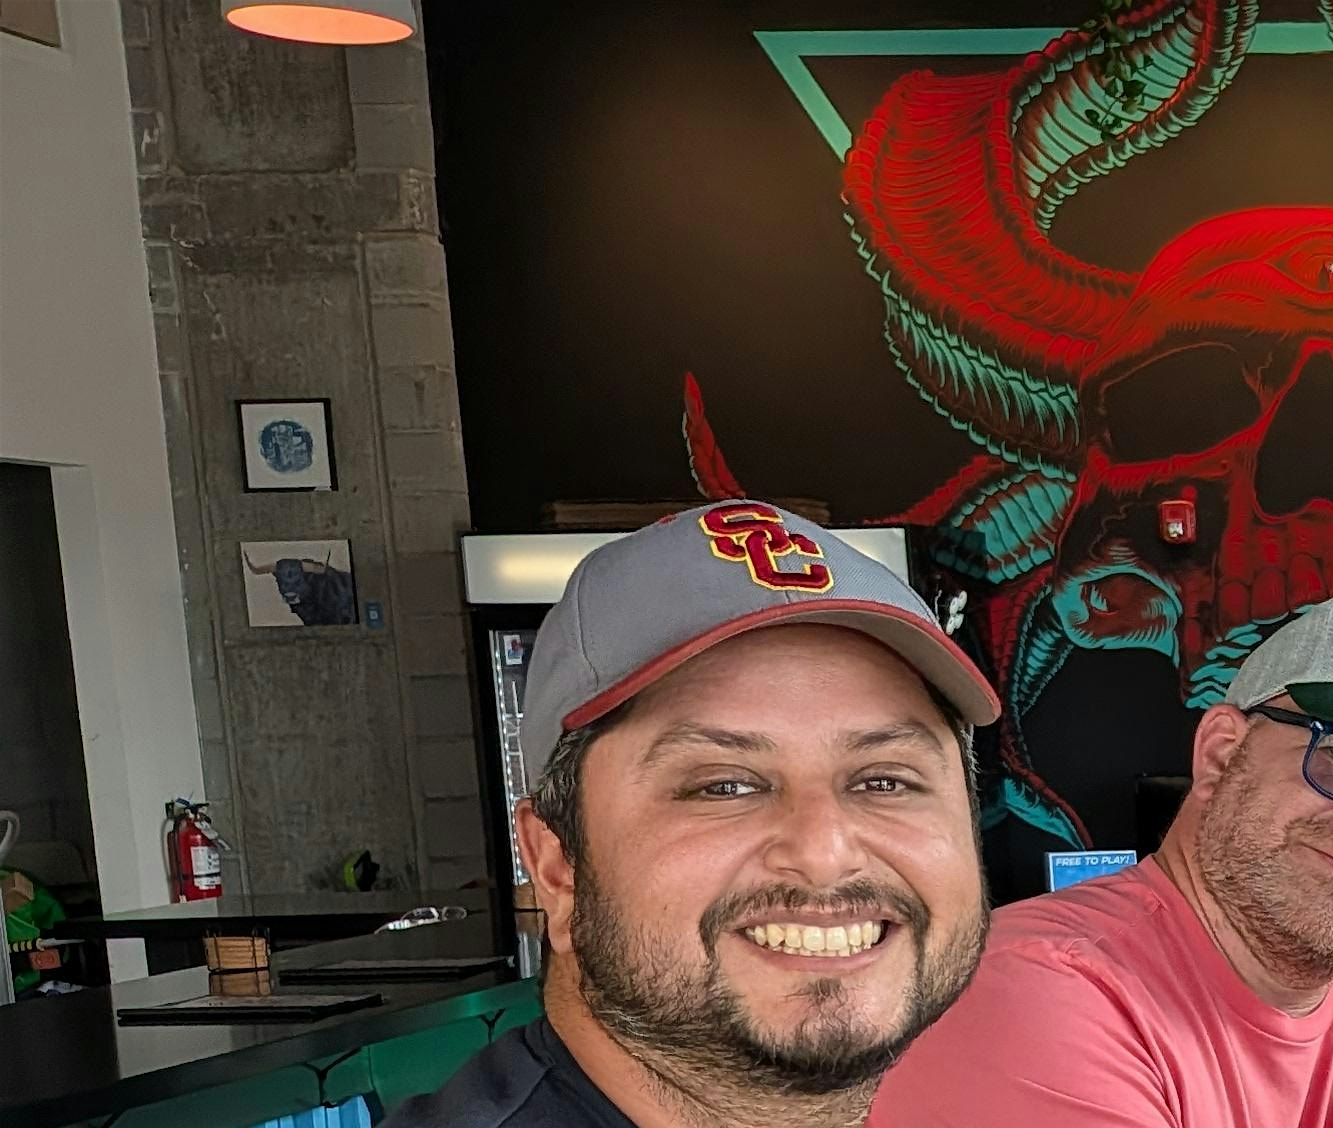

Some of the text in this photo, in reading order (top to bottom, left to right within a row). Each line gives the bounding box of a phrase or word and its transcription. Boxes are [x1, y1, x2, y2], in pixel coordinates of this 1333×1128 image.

[1055, 855, 1129, 867] FREE TO PLAY!
